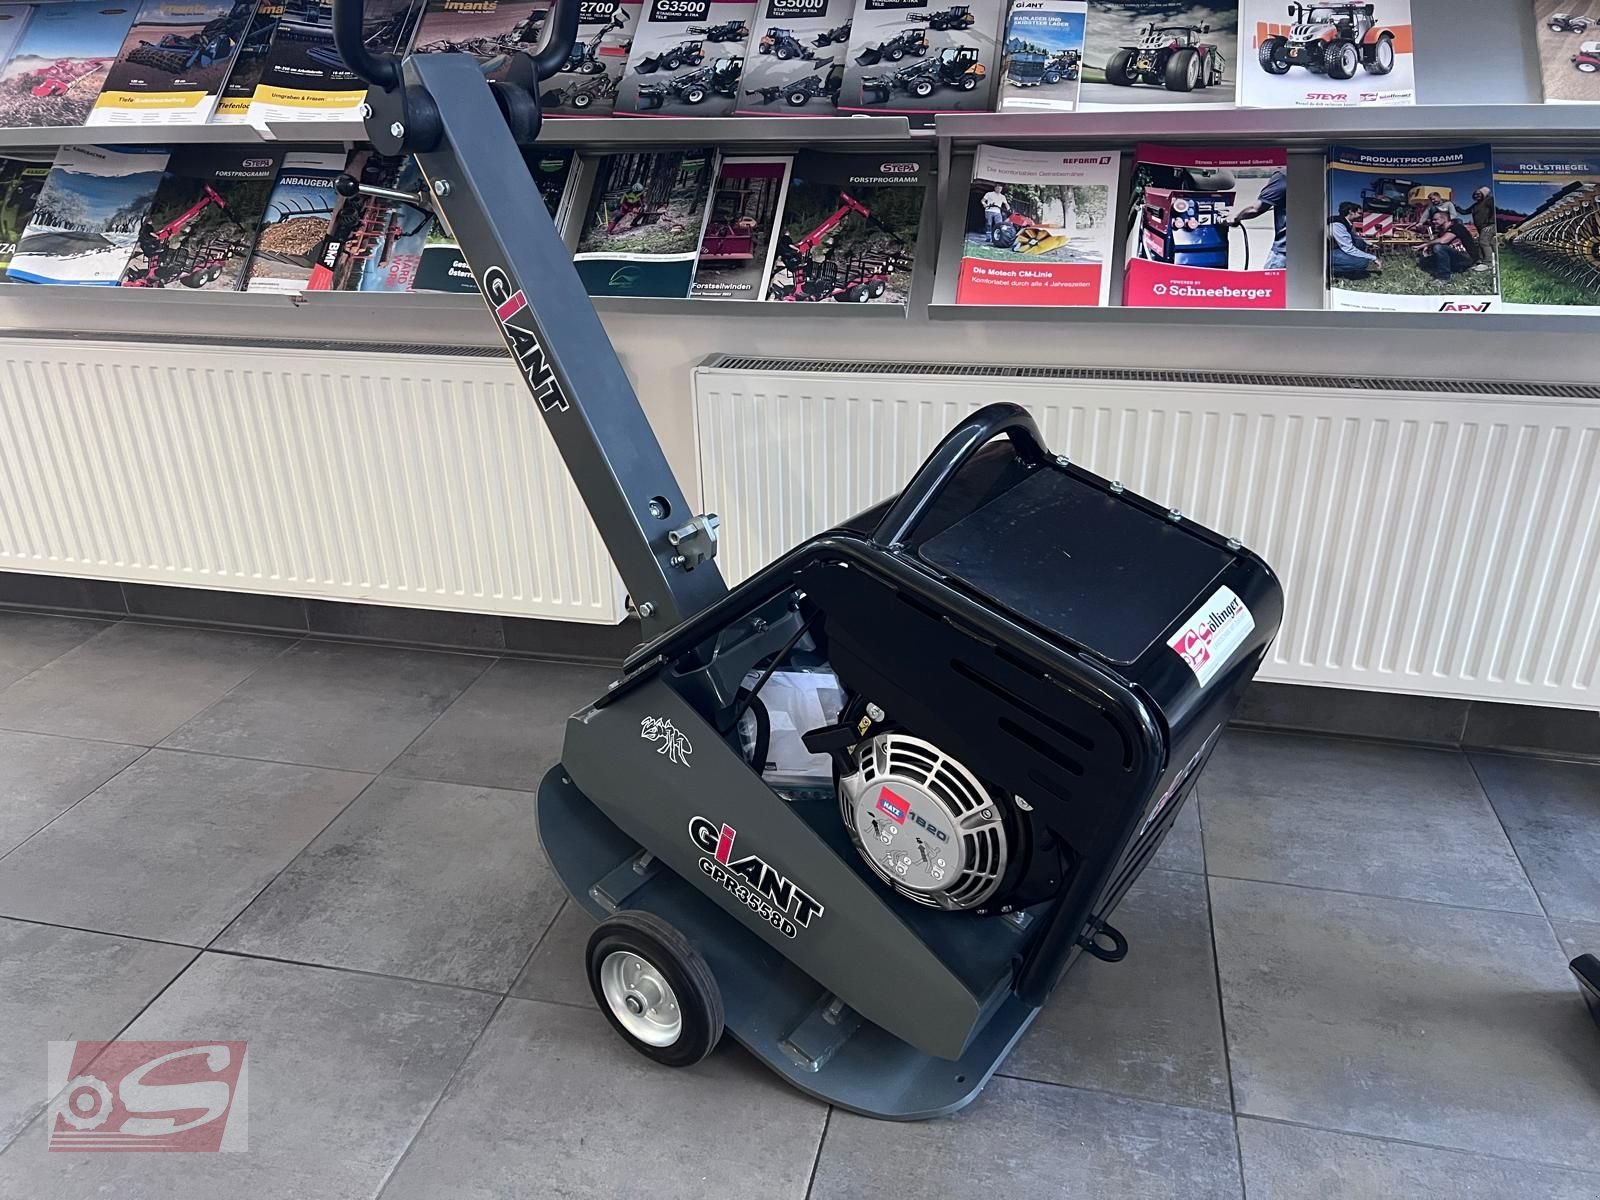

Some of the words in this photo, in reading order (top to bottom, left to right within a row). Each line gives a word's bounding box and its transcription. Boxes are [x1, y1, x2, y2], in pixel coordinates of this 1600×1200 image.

[580, 1, 614, 13] 2700
[657, 0, 706, 13] G3500
[774, 0, 823, 8] G5000
[1063, 157, 1098, 165] REFORM
[1360, 153, 1464, 164] PRODUKTPROGRAMM
[882, 163, 916, 172] STEPA
[323, 241, 341, 268] BMF
[988, 267, 1017, 277] Motech
[1018, 269, 1053, 278] CM-Linie
[691, 282, 751, 290] Forstseilwinden
[971, 276, 1010, 286] Komfortabel
[1011, 279, 1029, 287] durch
[1049, 280, 1091, 288] Jahreszeiten
[1169, 285, 1273, 300] Schneeberger
[1443, 303, 1487, 312] APV
[1198, 597, 1240, 646] Söllinger
[882, 802, 902, 817] HATZ
[698, 856, 798, 939] GPR3558D
